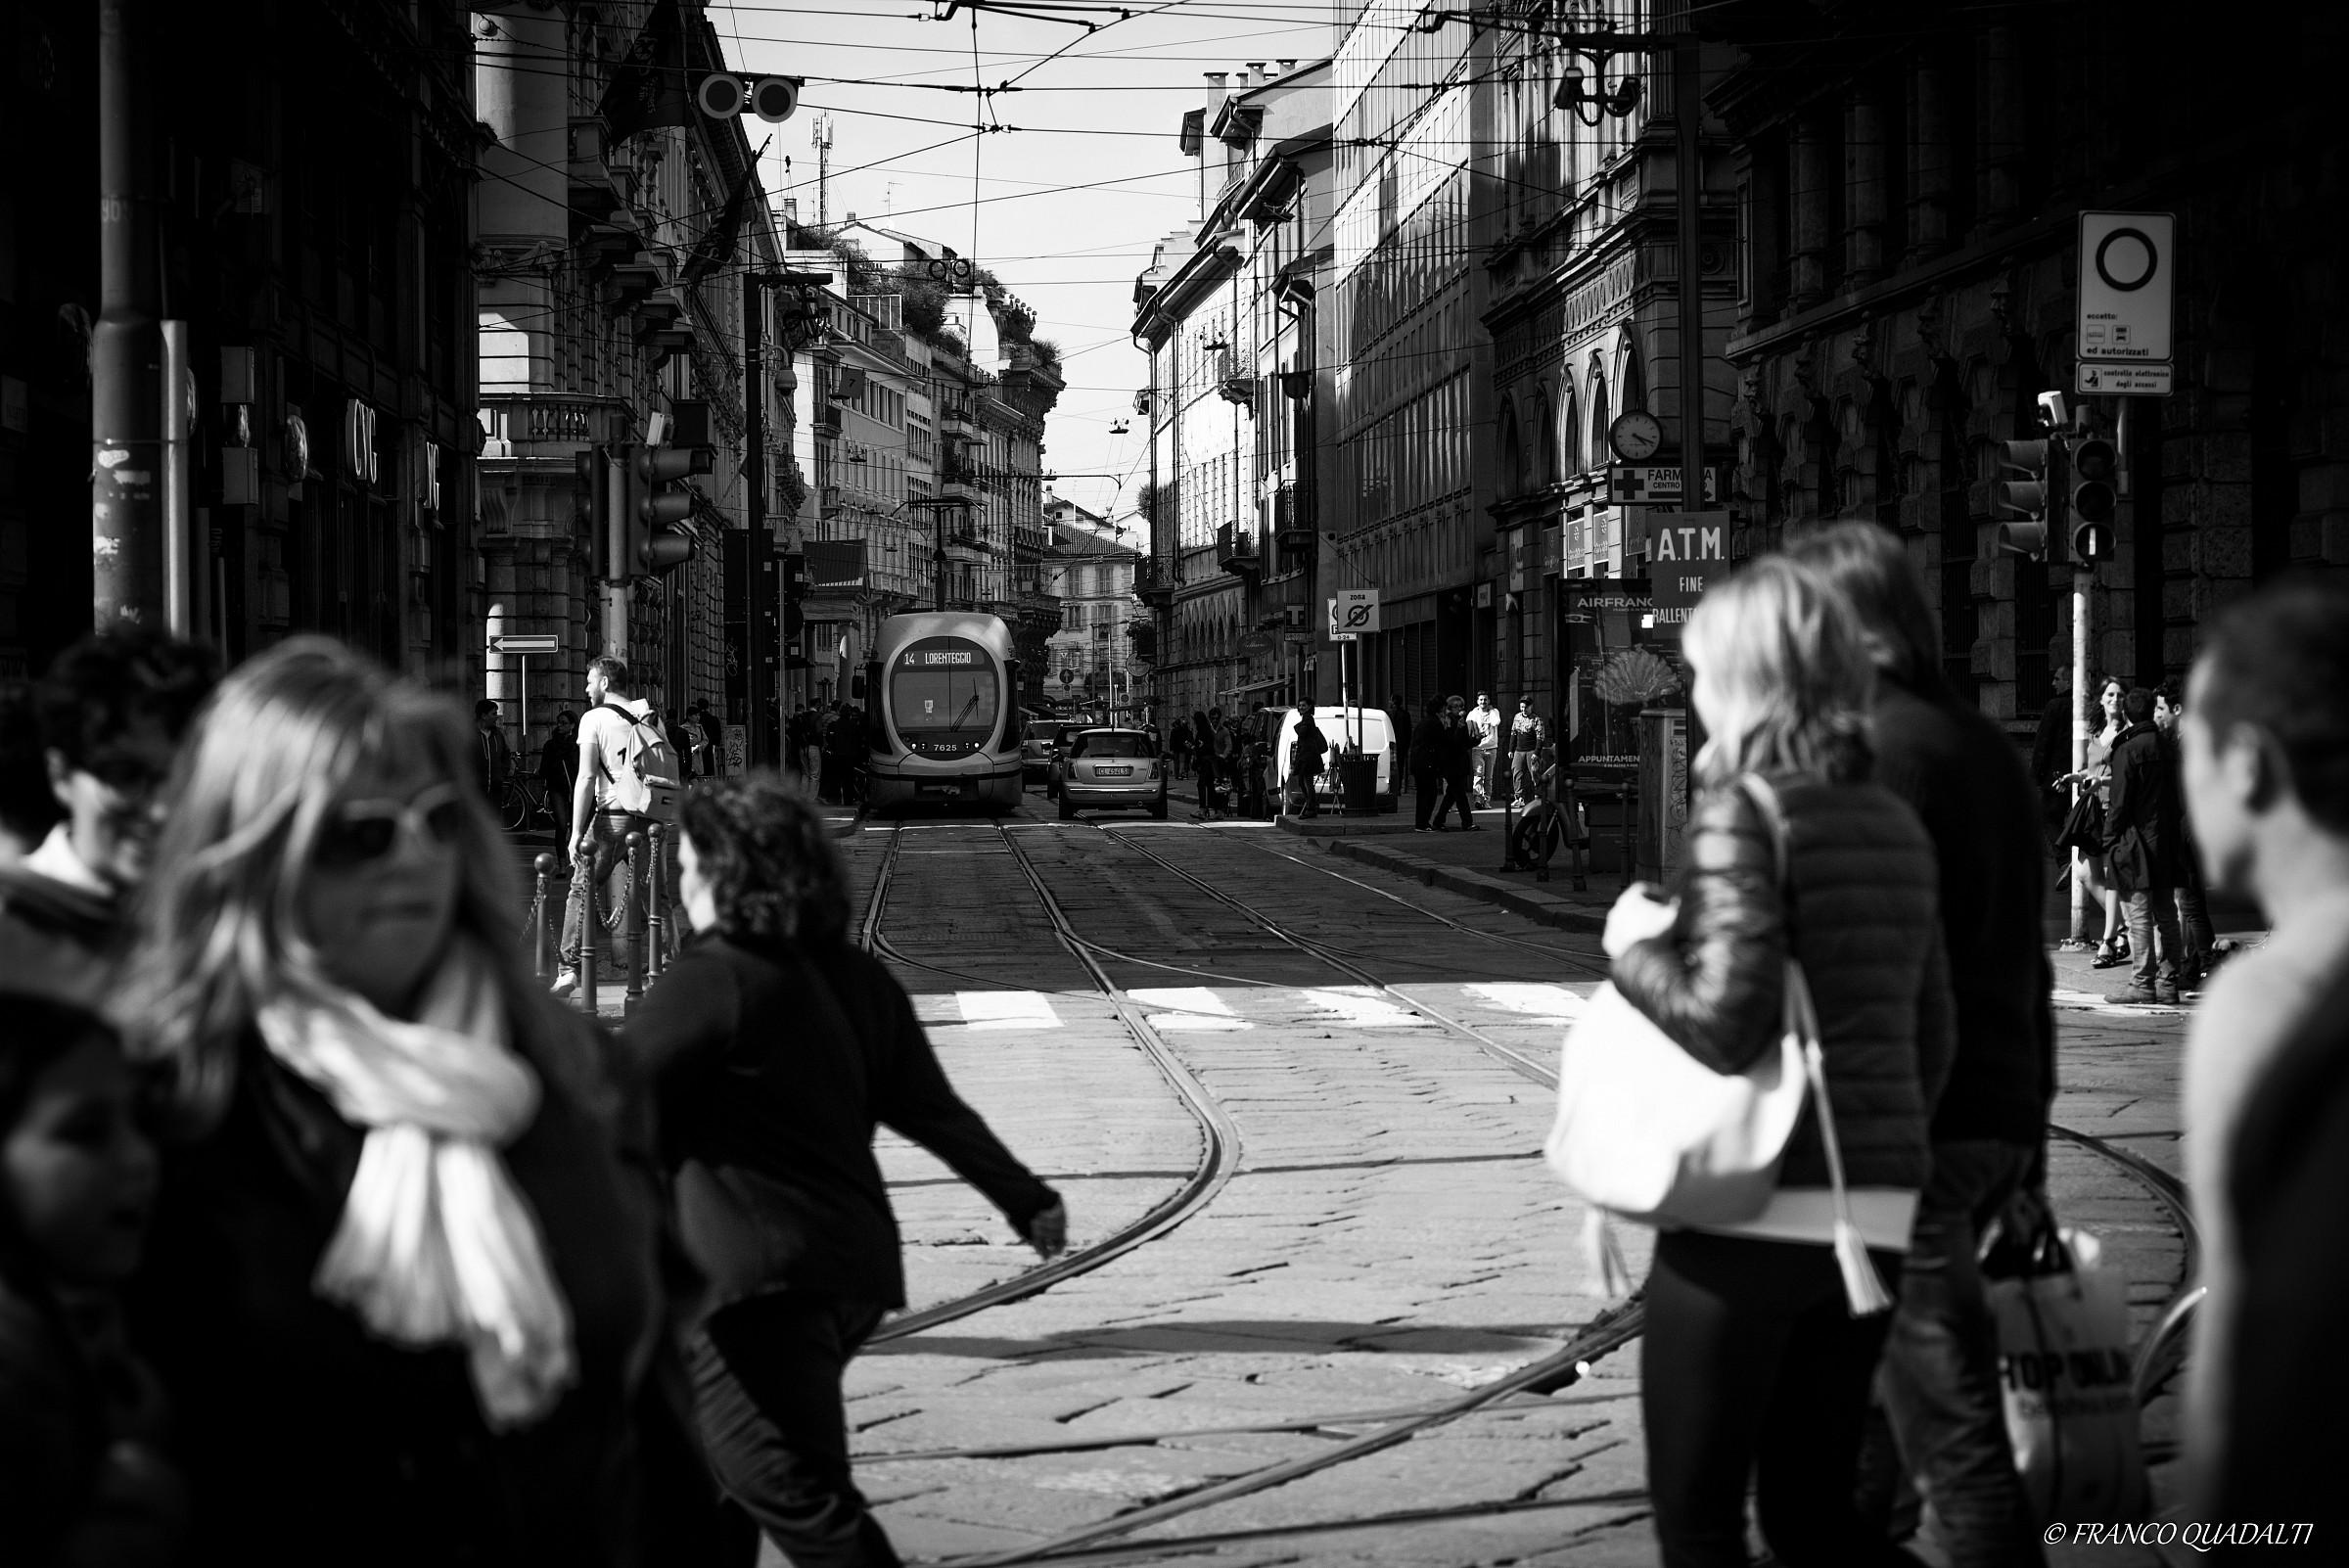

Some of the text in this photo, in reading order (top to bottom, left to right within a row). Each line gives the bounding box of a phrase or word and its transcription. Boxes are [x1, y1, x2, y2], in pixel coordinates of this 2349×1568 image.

[2087, 346, 2149, 356] ed autorizzati
[2135, 369, 2170, 378] elettronico
[849, 379, 855, 388] 7
[2116, 380, 2157, 389] degli accessi
[1648, 469, 1713, 481] FARMA
[1657, 526, 1725, 561] A.T.M.
[1680, 576, 1703, 593] FINE
[1577, 597, 1652, 608] AIRFRANC
[1286, 605, 1305, 625] T
[1652, 607, 1698, 624] RALLENT
[904, 653, 971, 665] 14 LORENTEGGIO
[1578, 755, 1639, 763] APPUNTAMEN
